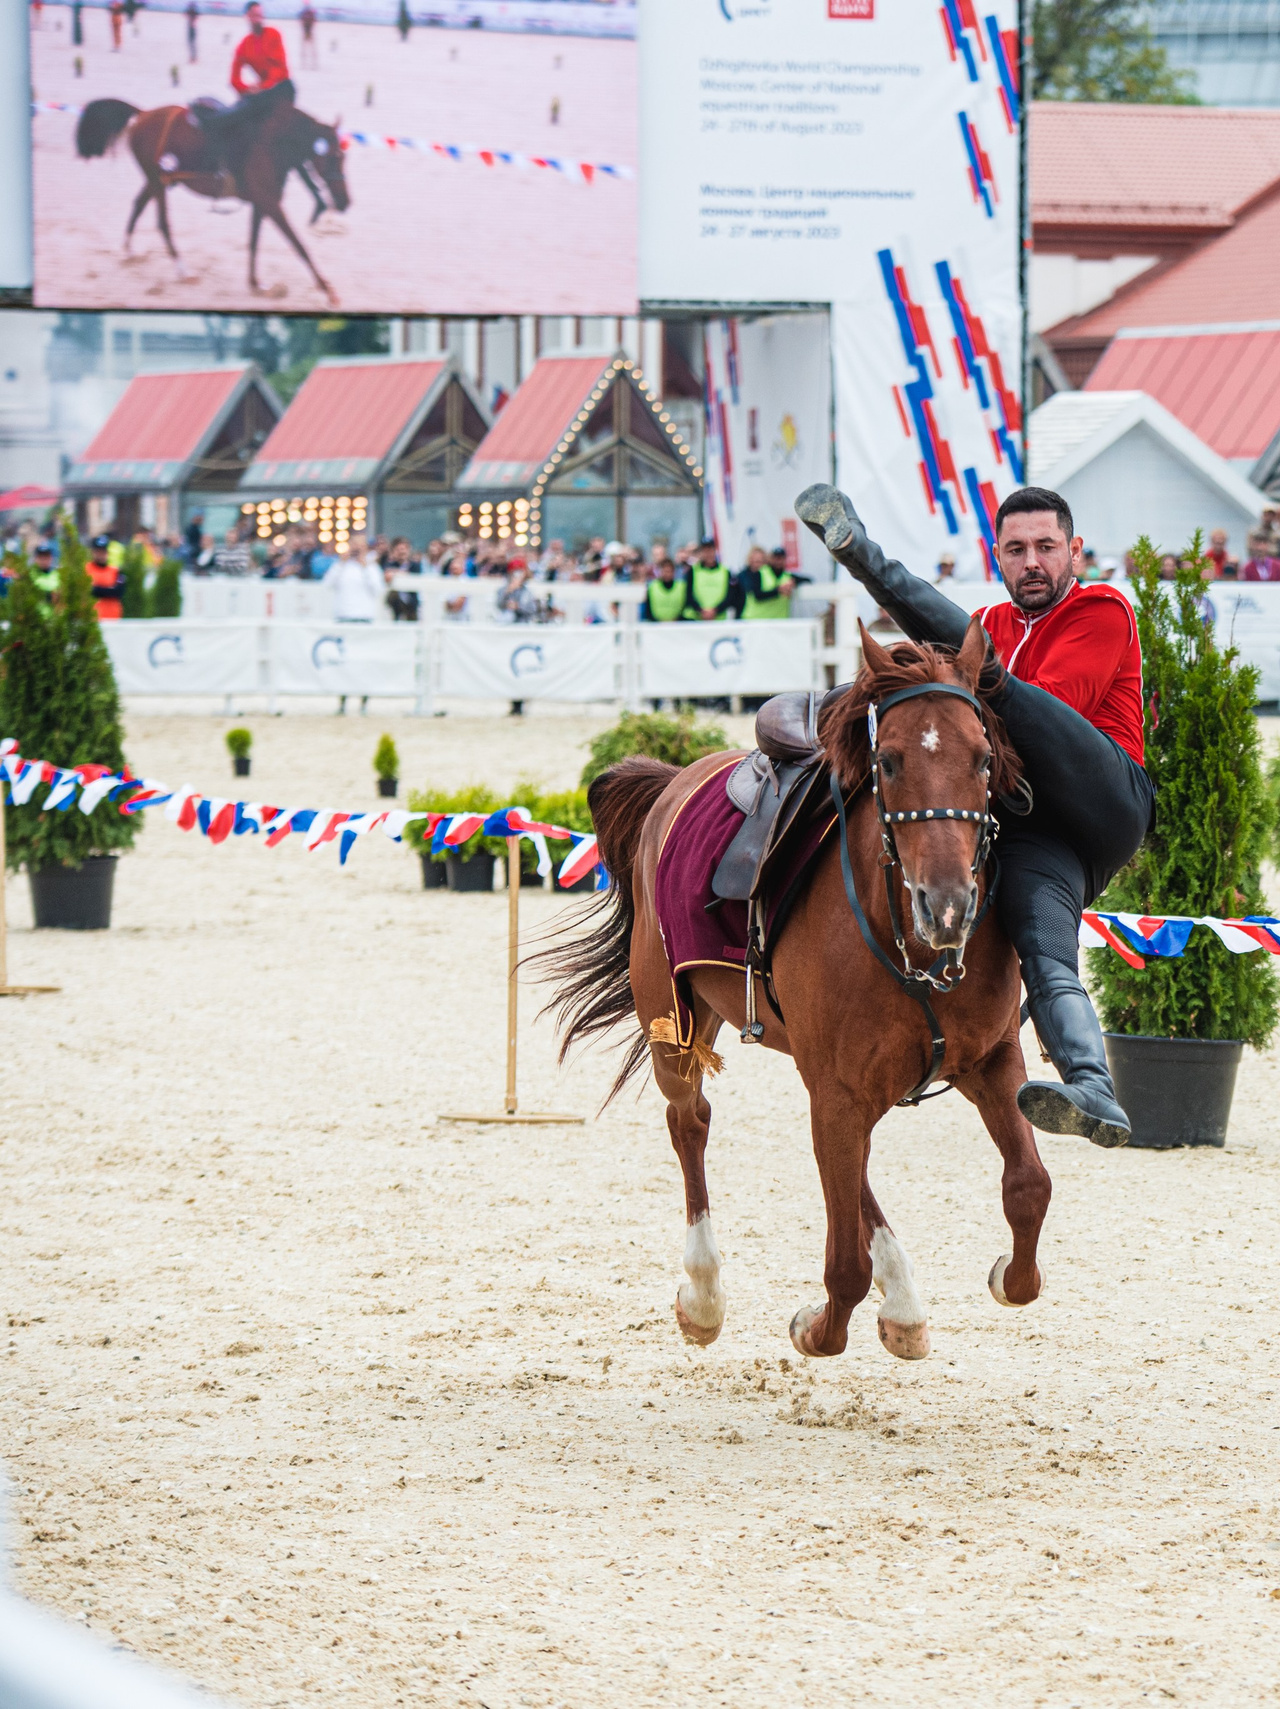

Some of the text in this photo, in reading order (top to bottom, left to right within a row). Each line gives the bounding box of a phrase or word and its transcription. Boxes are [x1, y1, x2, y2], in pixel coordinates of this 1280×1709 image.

[782, 60, 820, 73] World
[823, 60, 922, 78] Championship
[760, 80, 805, 93] Center
[808, 80, 823, 93] of
[824, 80, 882, 95] National
[700, 100, 838, 115] equestrian traditions
[760, 119, 777, 133] of
[779, 120, 826, 137] August
[760, 185, 803, 200] Центр
[806, 188, 915, 201] национальных
[700, 206, 828, 220] конных традиций
[728, 224, 746, 238] 27
[749, 228, 803, 241] августа
